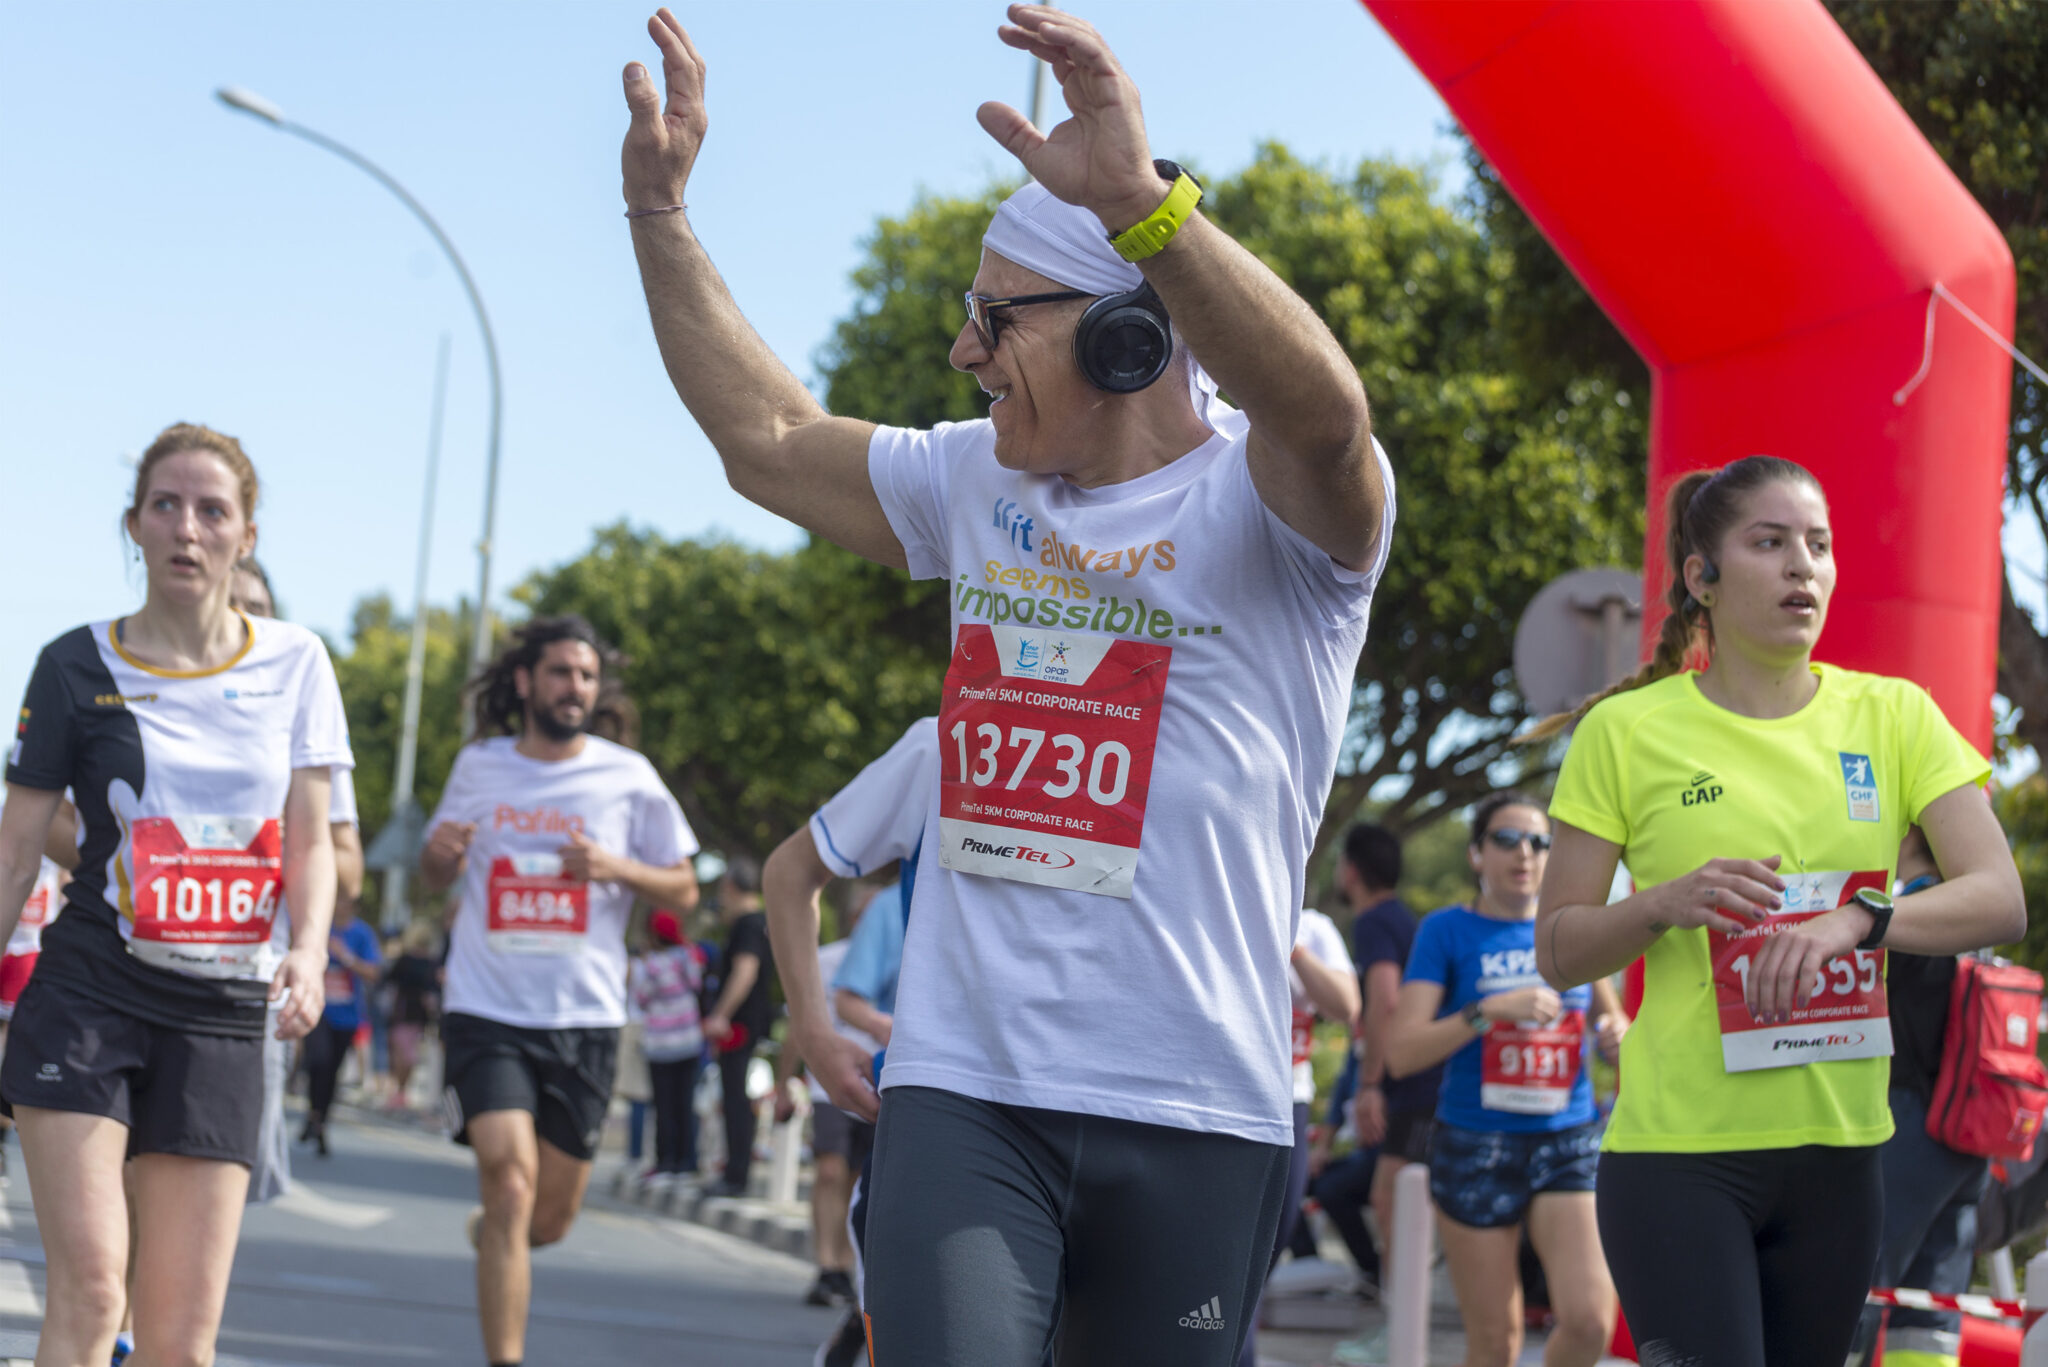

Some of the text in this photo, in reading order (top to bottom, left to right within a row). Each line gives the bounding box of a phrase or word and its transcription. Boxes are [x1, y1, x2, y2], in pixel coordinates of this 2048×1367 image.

[1040, 531, 1176, 578] always
[985, 560, 1091, 599] seems
[956, 573, 1222, 639] impossible...
[1043, 674, 1067, 682] CYPRUS
[959, 686, 1141, 720] PrimeTel 5KM CORPORATE RACE
[951, 720, 1131, 806] 13730
[1681, 786, 1723, 807] CAP
[960, 801, 1094, 831] PrimeTel 5KM CORPORATE RACE
[151, 876, 276, 924] 10164
[498, 890, 575, 923] 8494
[1810, 1006, 1851, 1017] CORPORATE
[1500, 1044, 1569, 1079] 9131
[1178, 1316, 1225, 1330] adidas
